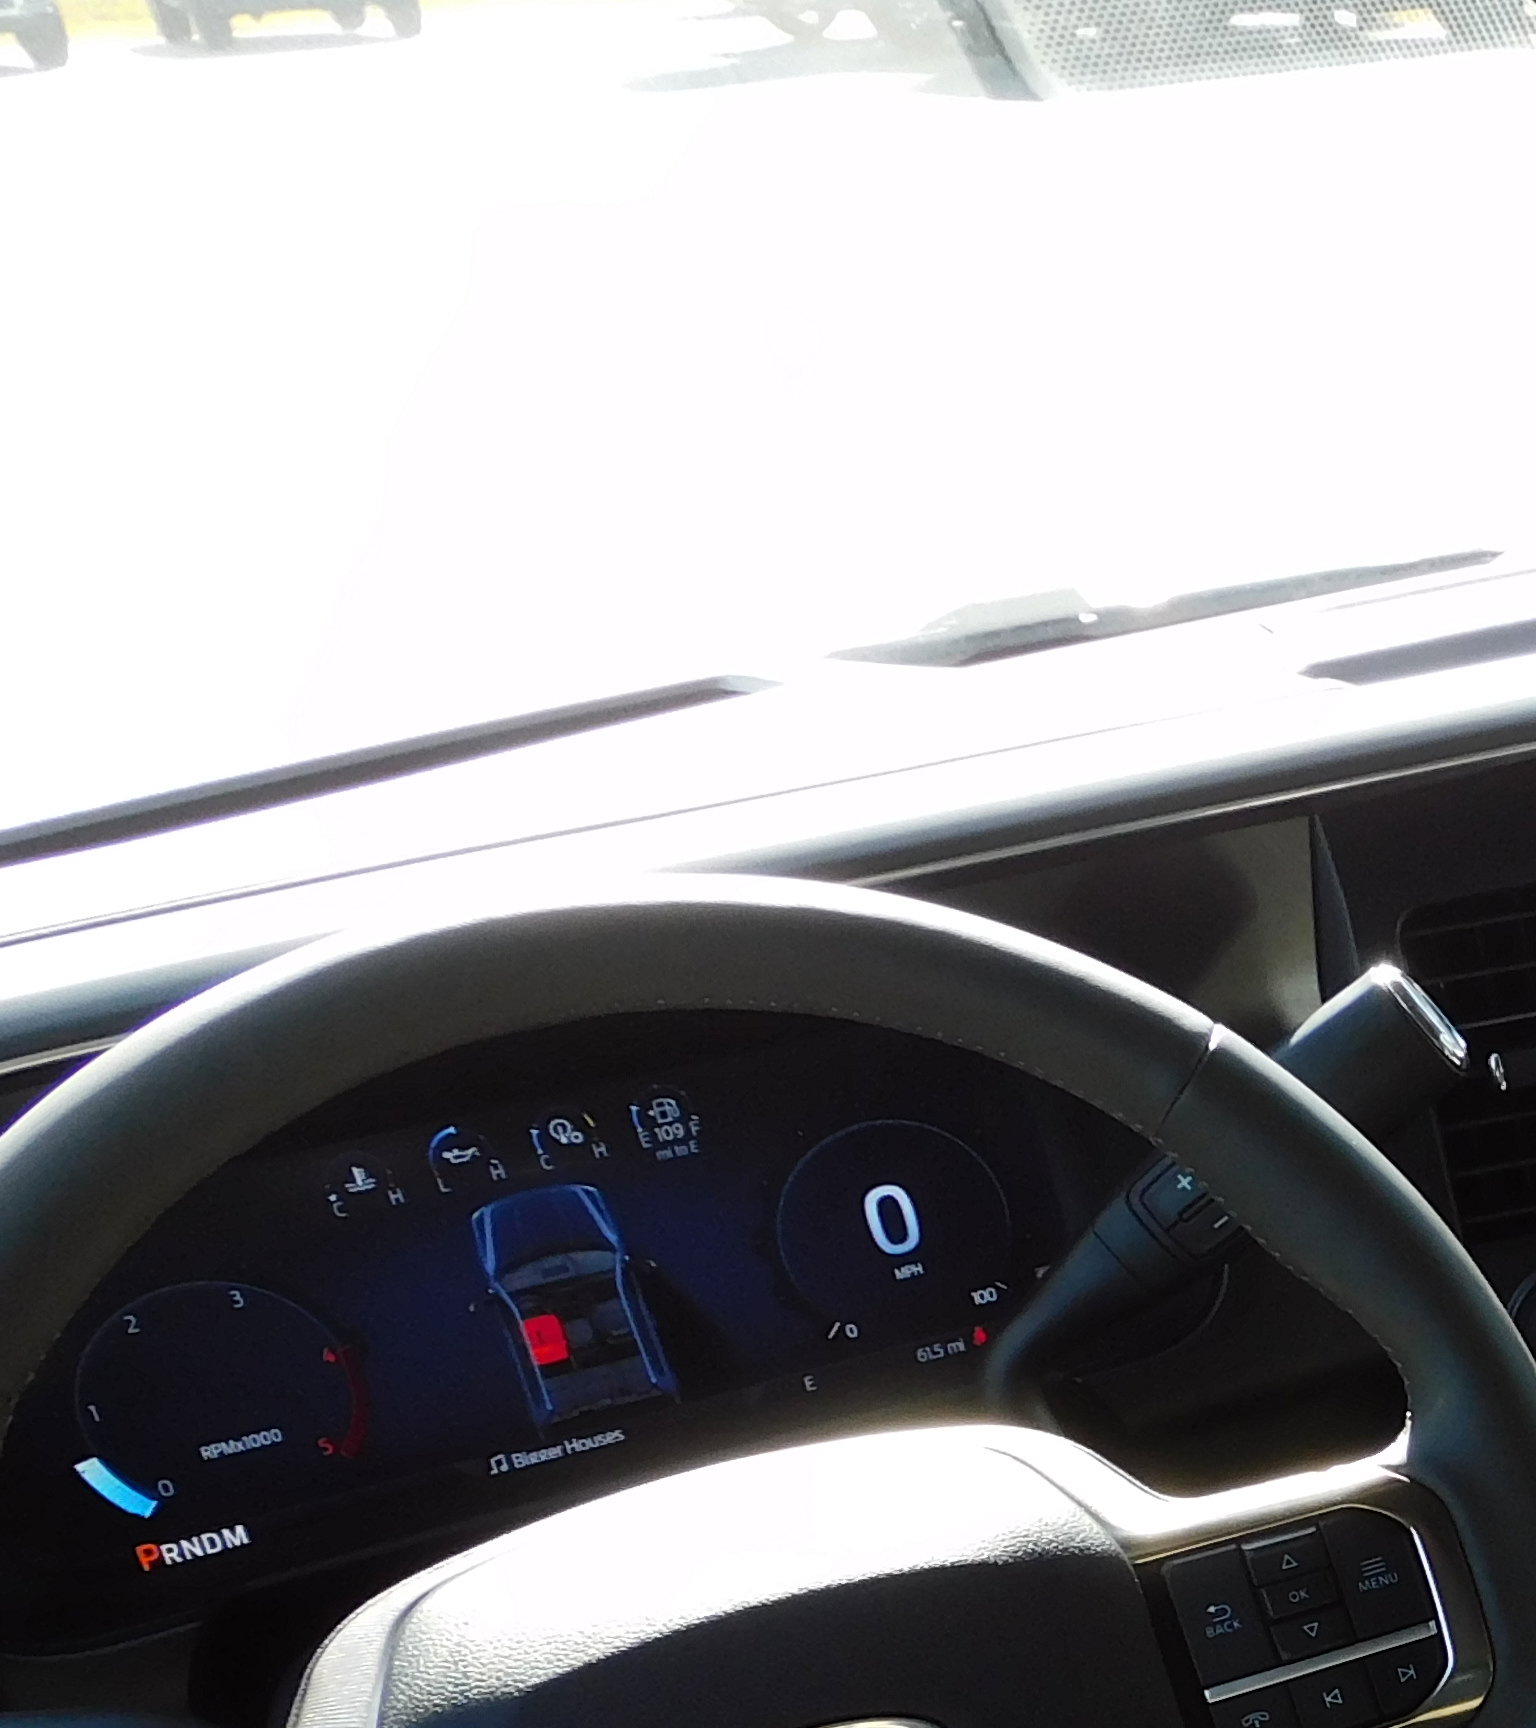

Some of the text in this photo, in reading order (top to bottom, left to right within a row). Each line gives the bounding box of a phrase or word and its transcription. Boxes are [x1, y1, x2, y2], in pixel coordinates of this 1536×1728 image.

[640, 1120, 700, 1148] E 109 F
[592, 1141, 609, 1160] H
[688, 1140, 699, 1153] E
[538, 1153, 555, 1171] C
[489, 1163, 507, 1181] H
[437, 1177, 452, 1193] L
[387, 1188, 406, 1206] H
[332, 1201, 348, 1218] C
[863, 1184, 921, 1257] 0
[894, 1262, 925, 1281] MPH
[229, 1290, 244, 1309] 3
[969, 1286, 998, 1306] 100
[123, 1314, 141, 1334] 2
[844, 1322, 859, 1339] 0
[947, 1338, 967, 1355] mi
[803, 1375, 818, 1392] E
[88, 1404, 101, 1424] 1
[199, 1428, 284, 1463] RPMx1000
[318, 1438, 334, 1455] 5
[510, 1428, 625, 1472] Bigger Houses
[157, 1480, 175, 1498] 0
[134, 1524, 252, 1572] PRNDM
[1358, 1572, 1399, 1592] MENU
[1288, 1587, 1311, 1602] OK
[1204, 1619, 1243, 1638] BACK
